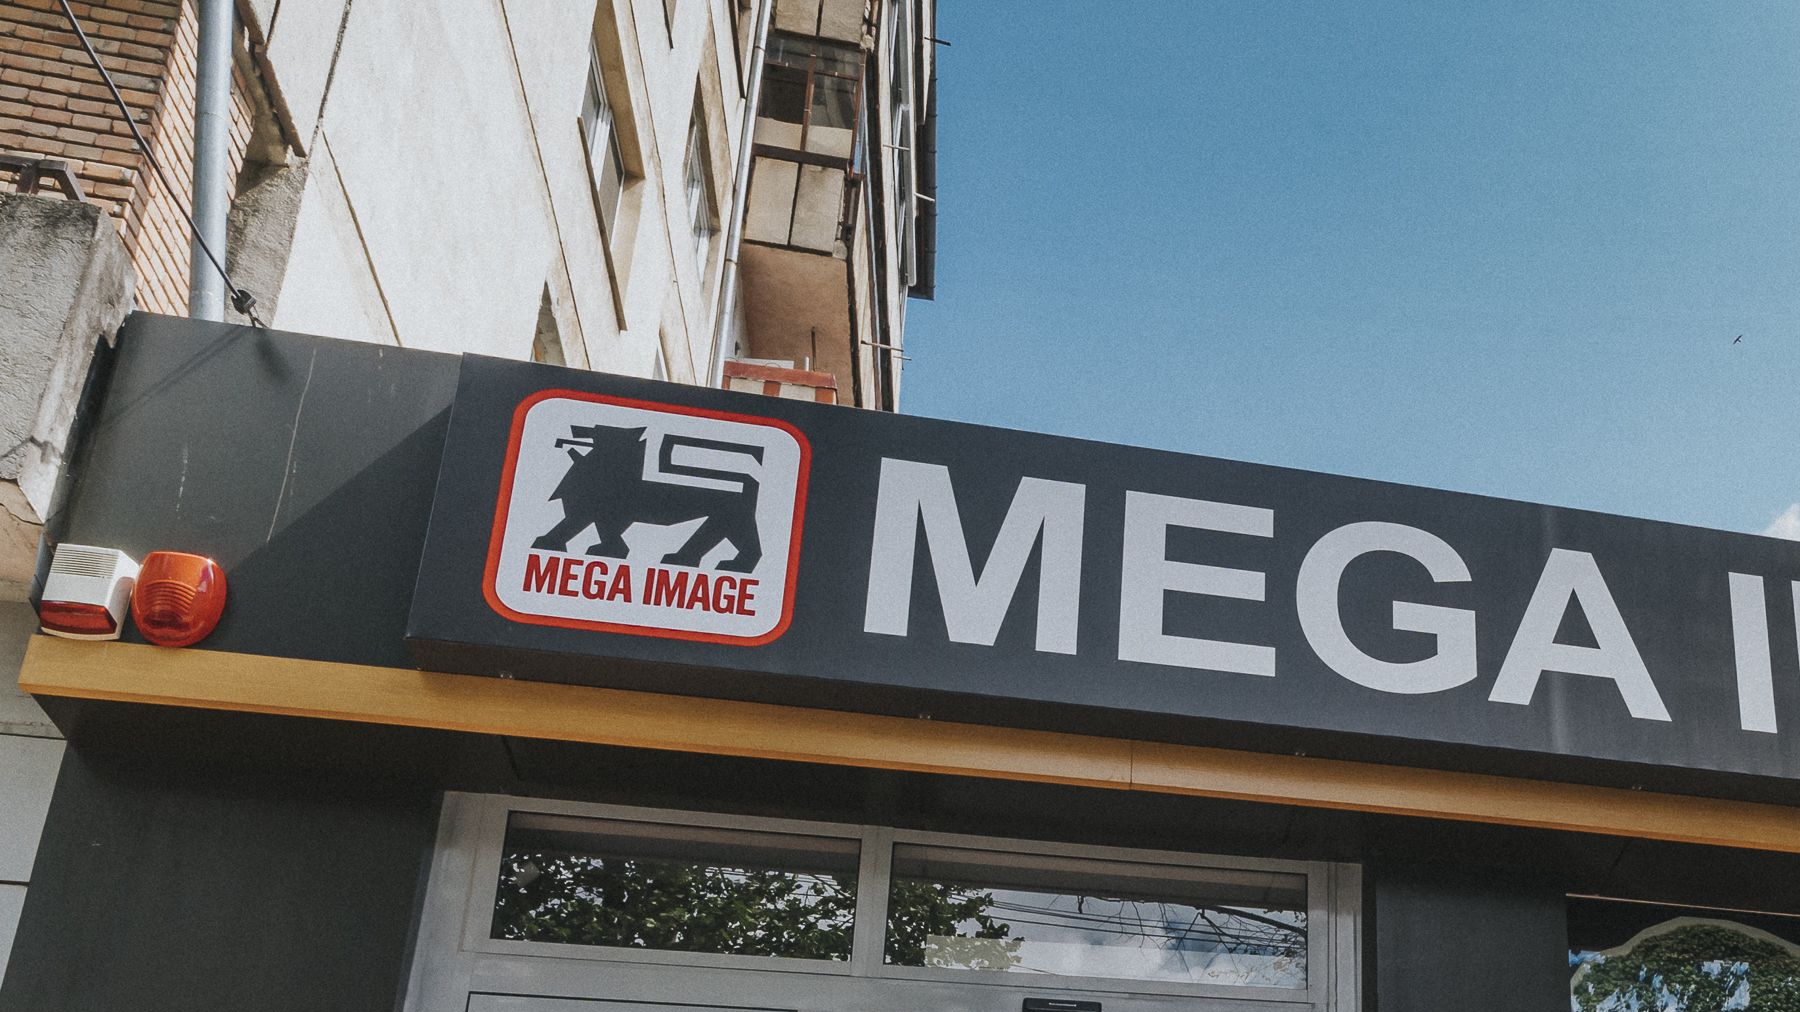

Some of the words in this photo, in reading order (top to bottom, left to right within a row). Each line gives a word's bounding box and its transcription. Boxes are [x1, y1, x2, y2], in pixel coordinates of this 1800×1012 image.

[522, 553, 633, 604] MEGA
[642, 567, 760, 617] IMAGE
[864, 457, 1673, 723] MEGA
